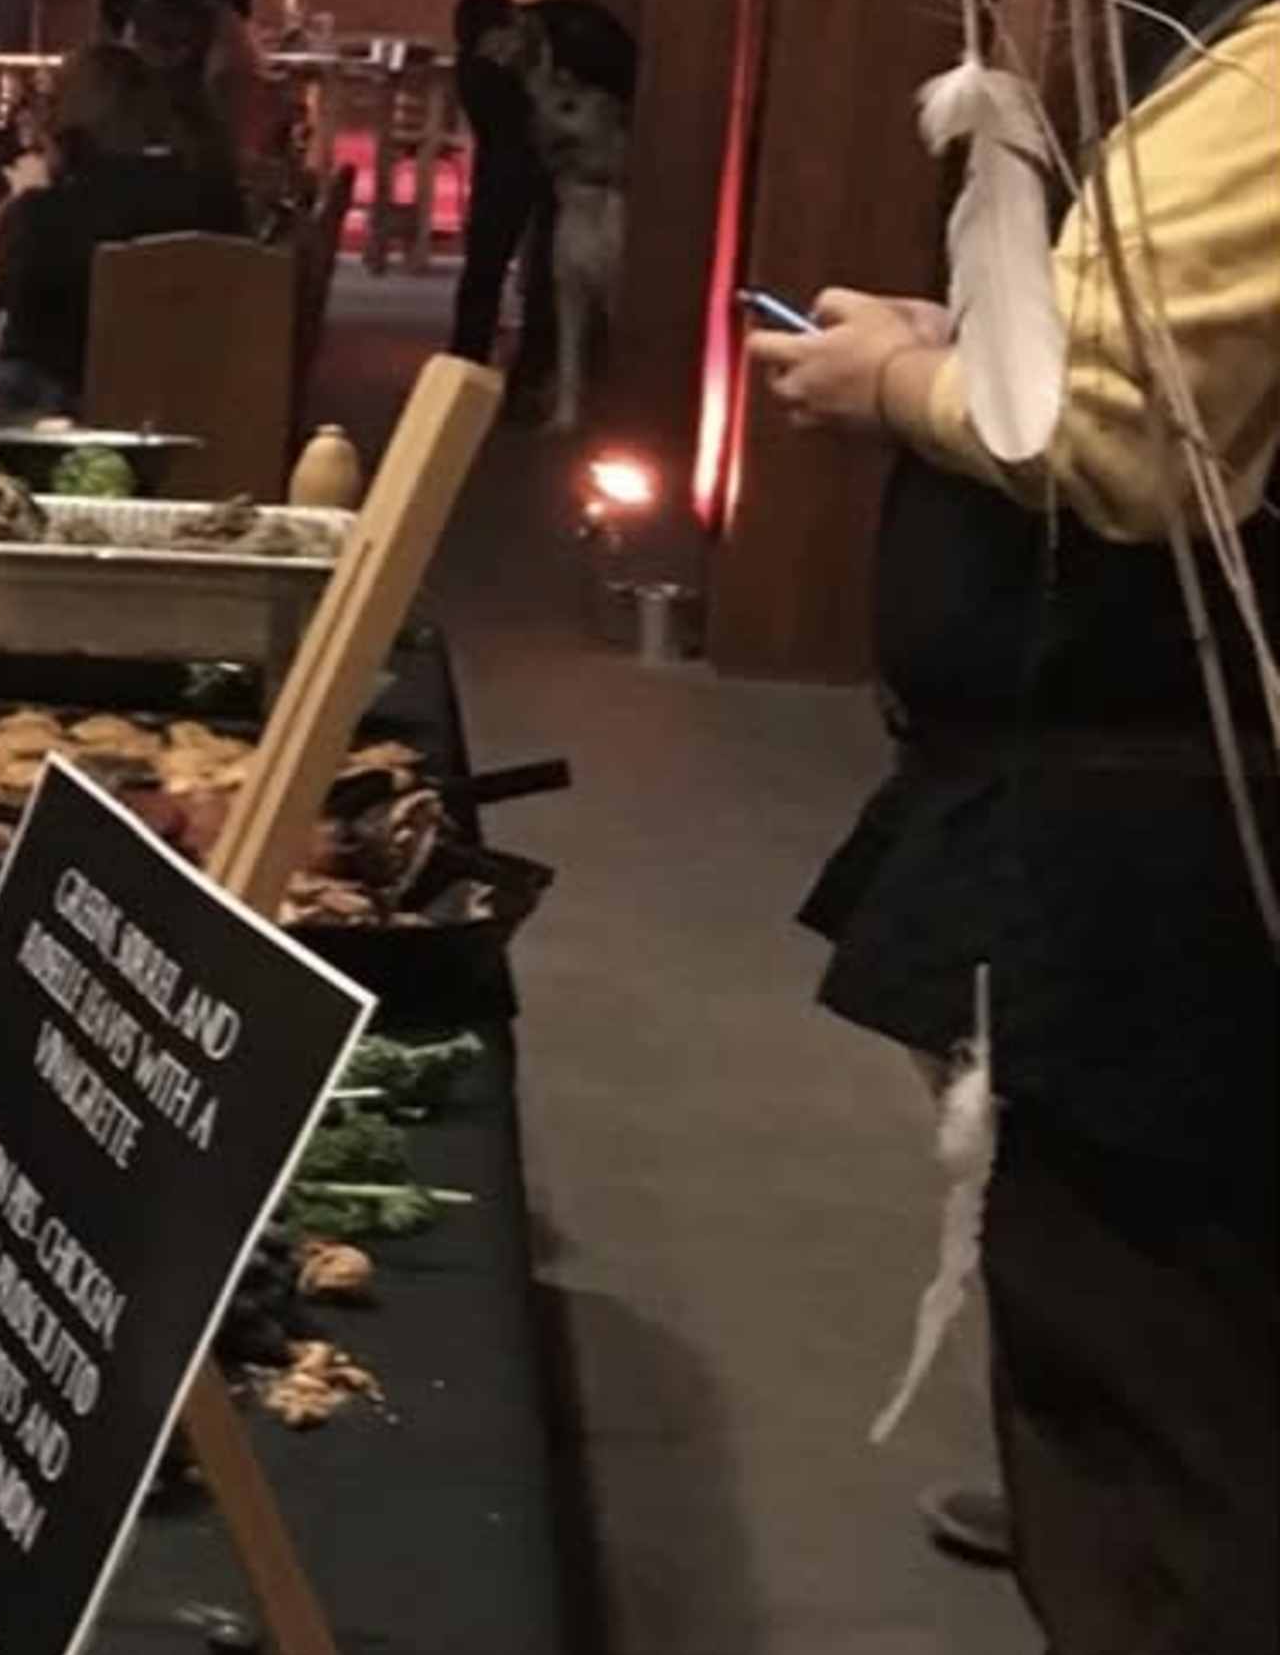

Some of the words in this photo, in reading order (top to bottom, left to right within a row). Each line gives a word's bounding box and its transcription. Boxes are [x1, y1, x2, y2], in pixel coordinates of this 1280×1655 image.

[172, 988, 240, 1061] AND
[134, 1034, 201, 1127] WITH
[187, 1098, 218, 1150] A
[15, 1402, 70, 1482] AND
